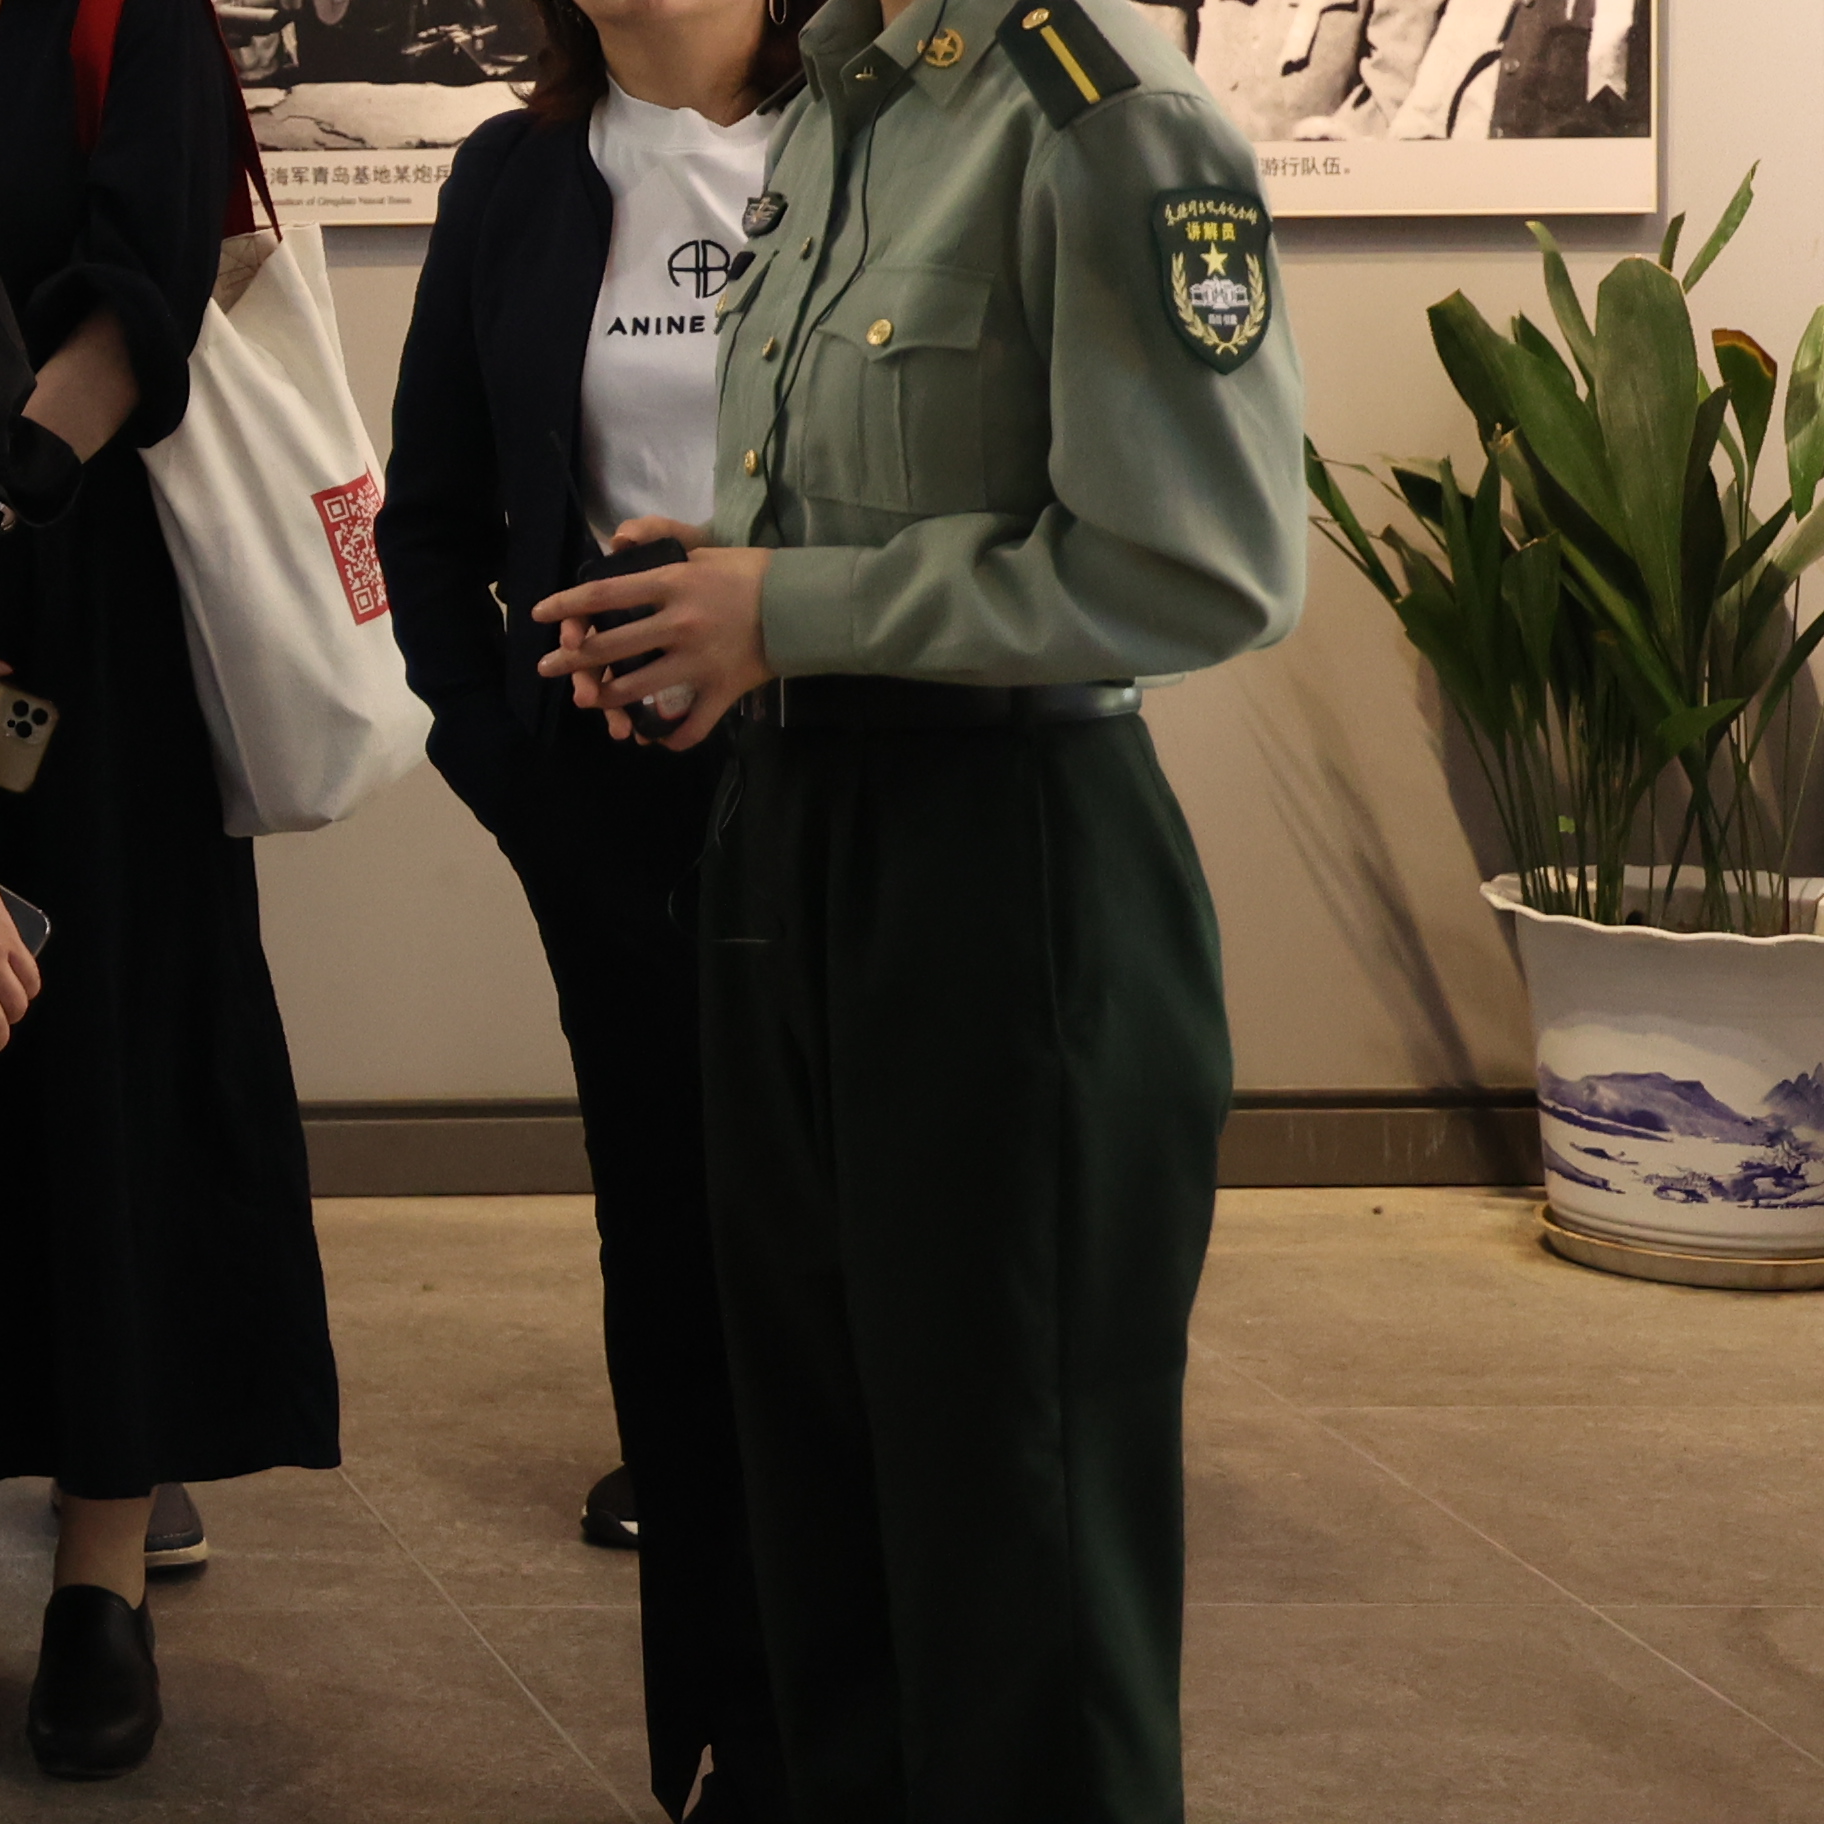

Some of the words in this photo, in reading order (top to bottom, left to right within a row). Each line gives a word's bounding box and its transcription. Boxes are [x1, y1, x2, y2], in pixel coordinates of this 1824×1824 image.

[263, 164, 451, 186] 海军青岛基地某炮兵
[1260, 157, 1351, 177] 游行队伍。
[607, 314, 706, 337] ANINE
